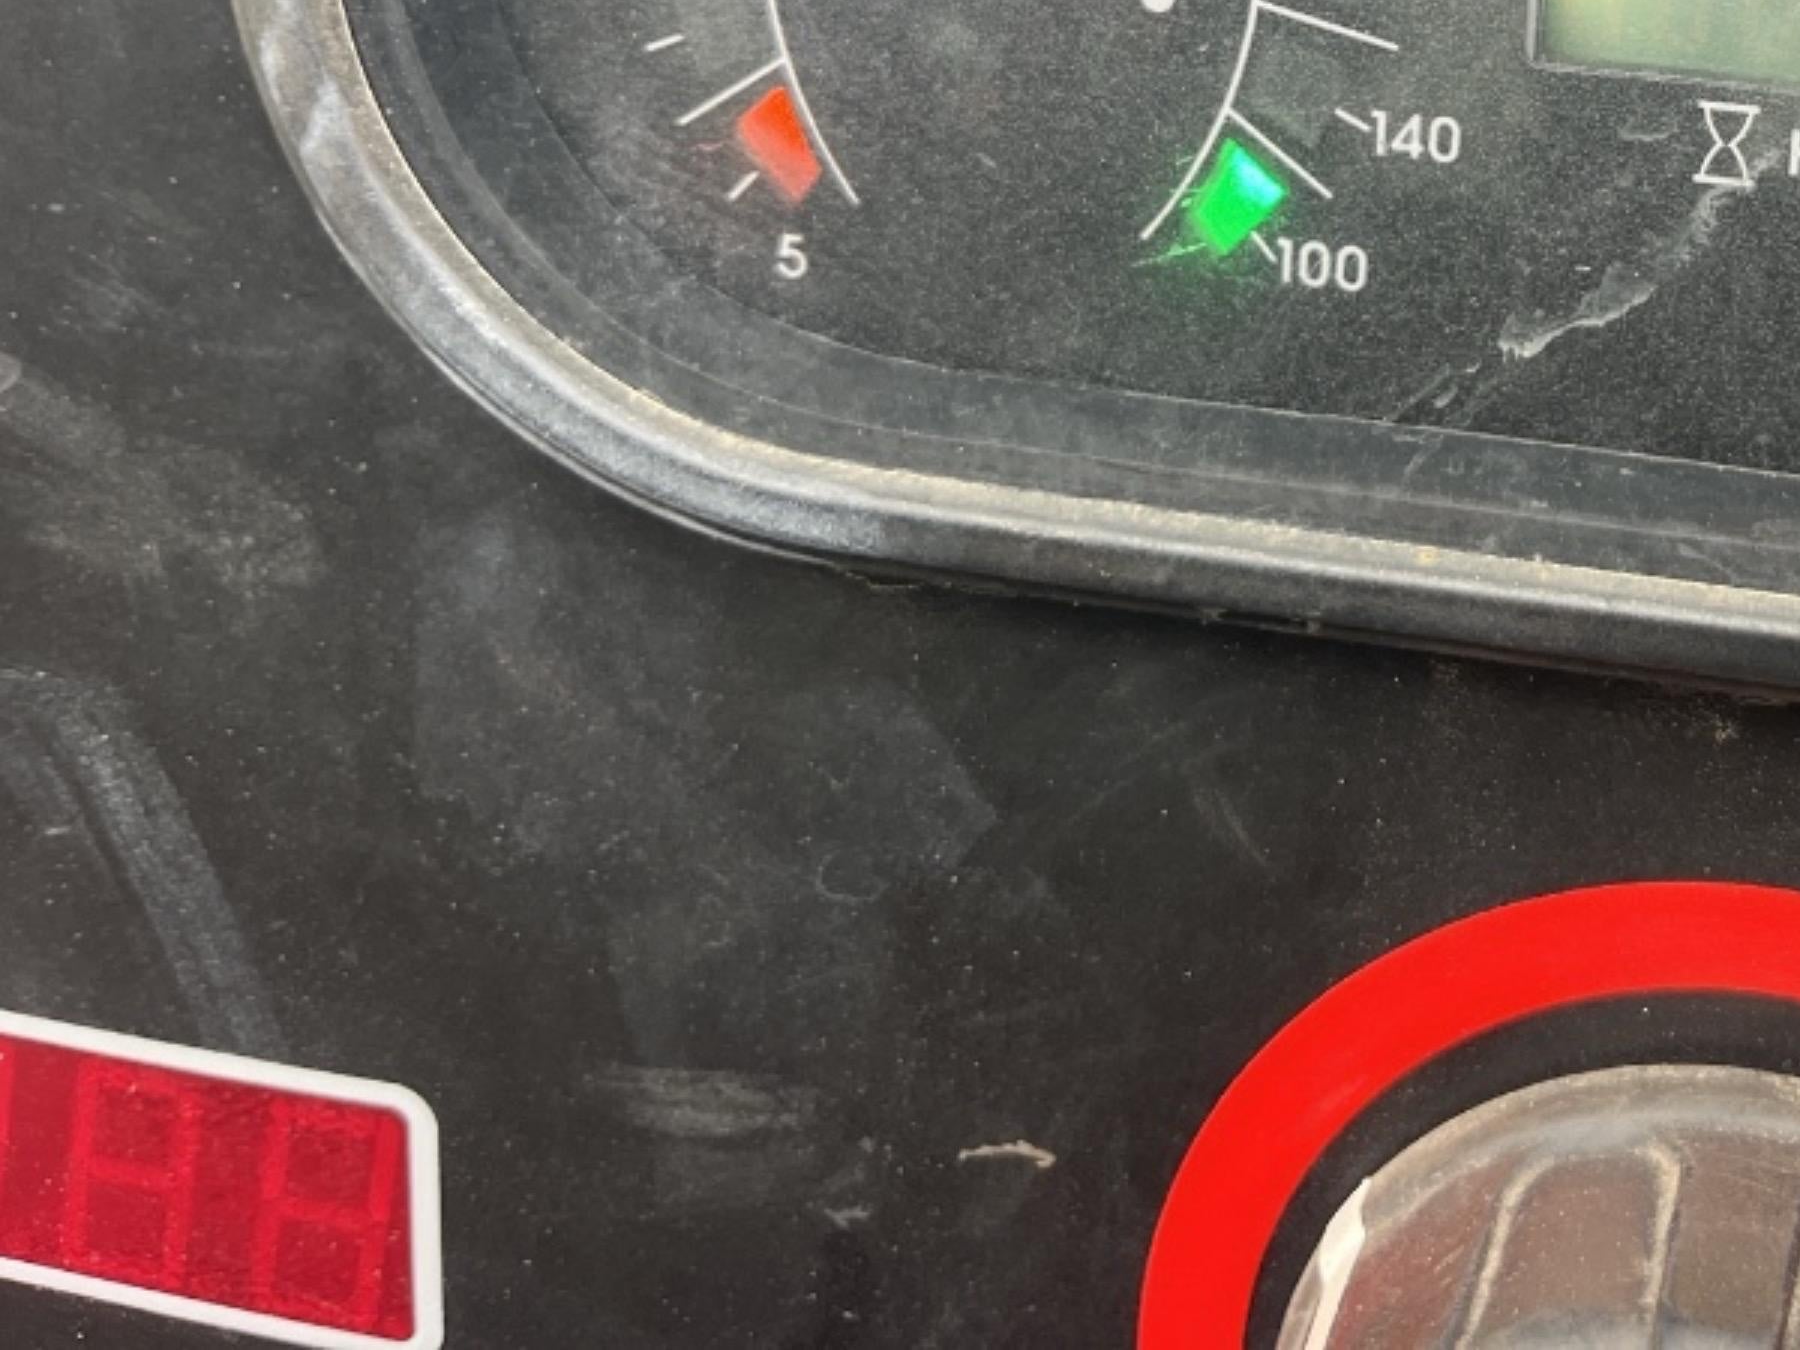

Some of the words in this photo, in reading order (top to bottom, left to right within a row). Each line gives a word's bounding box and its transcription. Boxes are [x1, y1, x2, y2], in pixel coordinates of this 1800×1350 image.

[1371, 111, 1461, 162] 140
[776, 236, 806, 278] 5
[1277, 239, 1367, 291] 100
